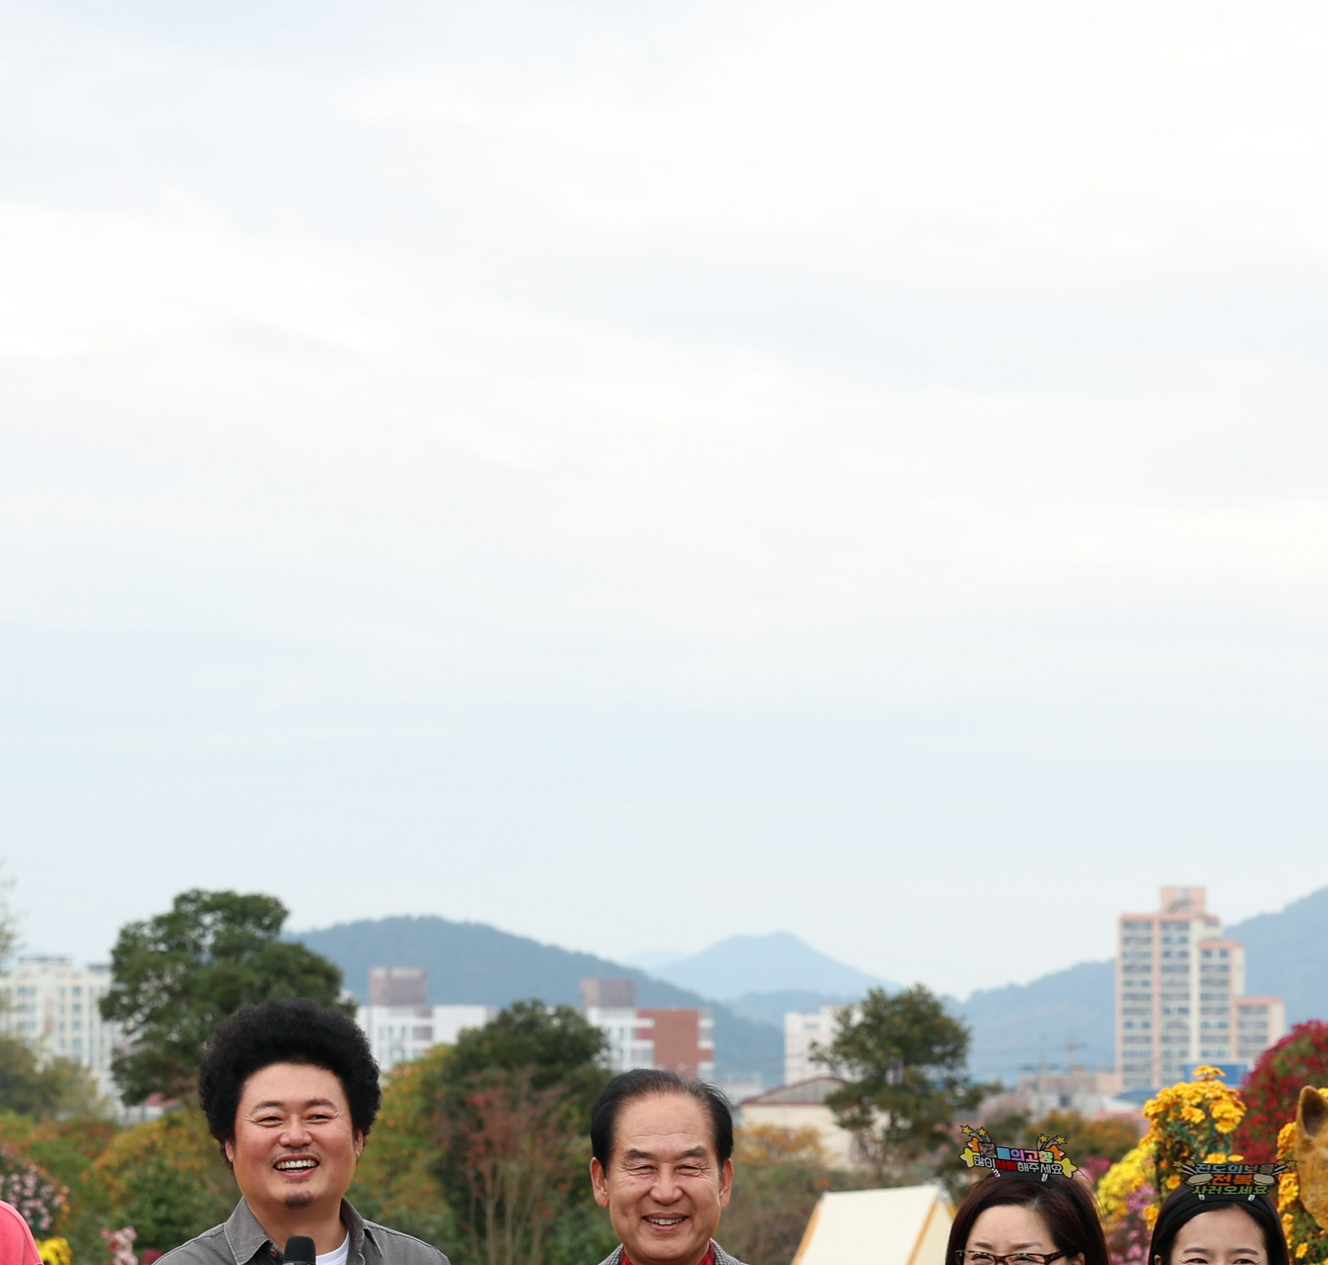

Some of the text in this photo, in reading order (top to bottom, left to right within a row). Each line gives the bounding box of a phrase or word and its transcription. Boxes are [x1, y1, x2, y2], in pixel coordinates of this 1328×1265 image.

[979, 1142, 1054, 1163] 의고향
[1195, 1163, 1274, 1174] 진도의보
[1192, 1185, 1269, 1195] 사러오세요
